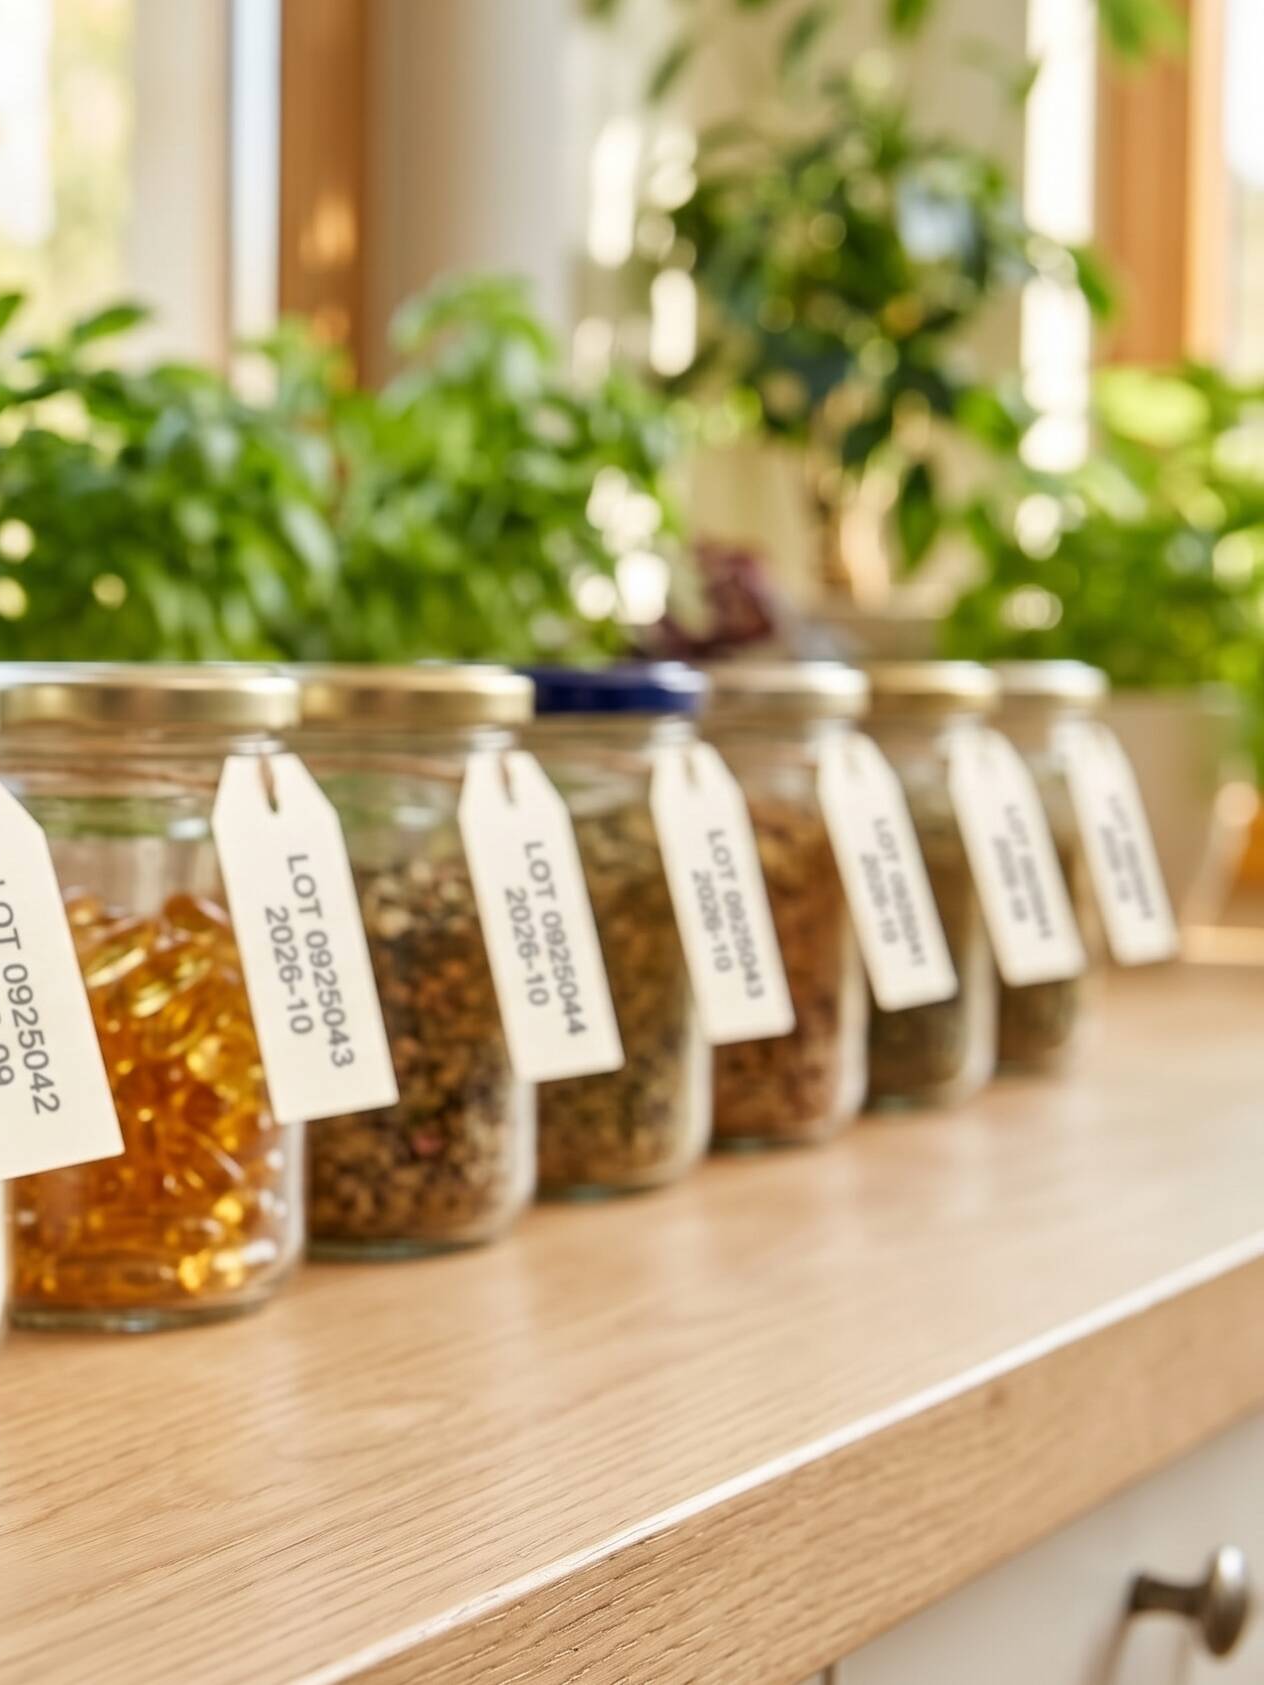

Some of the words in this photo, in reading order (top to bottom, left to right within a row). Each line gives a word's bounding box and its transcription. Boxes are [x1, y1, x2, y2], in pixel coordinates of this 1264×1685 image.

[707, 829, 737, 881] LOT
[265, 906, 314, 1035] 2026-10
[287, 854, 322, 918] LOT
[305, 930, 354, 1068] 0925043
[505, 888, 549, 1006] 2026-10
[524, 842, 556, 900] LOT
[542, 911, 587, 1035] 0925044
[3, 964, 60, 1114] 0925042
